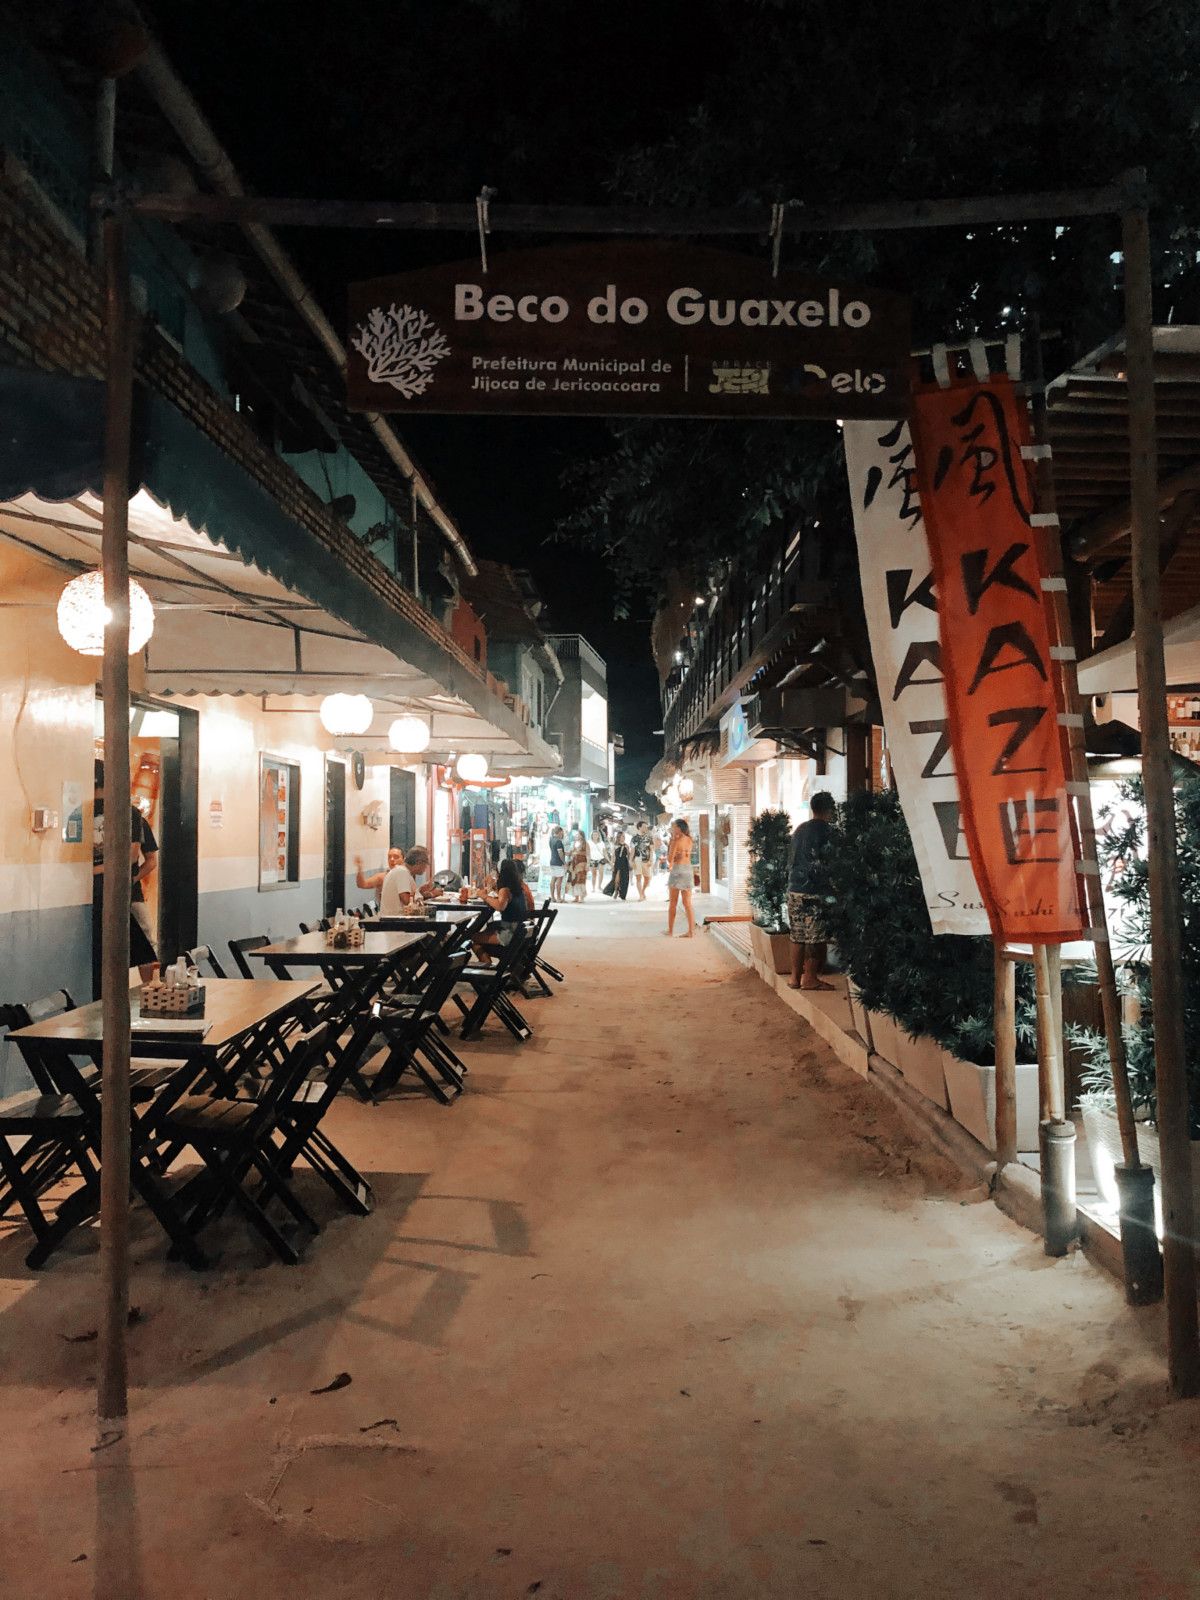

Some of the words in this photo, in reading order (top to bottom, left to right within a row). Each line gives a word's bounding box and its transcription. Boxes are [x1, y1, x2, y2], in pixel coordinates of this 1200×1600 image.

[454, 284, 570, 322] Beco
[586, 284, 649, 324] do
[666, 287, 872, 328] Guaxelo
[471, 356, 558, 371] Prefeitura
[562, 358, 646, 375] Municipal
[651, 359, 673, 373] de
[471, 376, 520, 393] Jijoca
[525, 377, 547, 391] de
[552, 378, 661, 392] Jericoacoara
[960, 542, 1063, 865] KAZE
